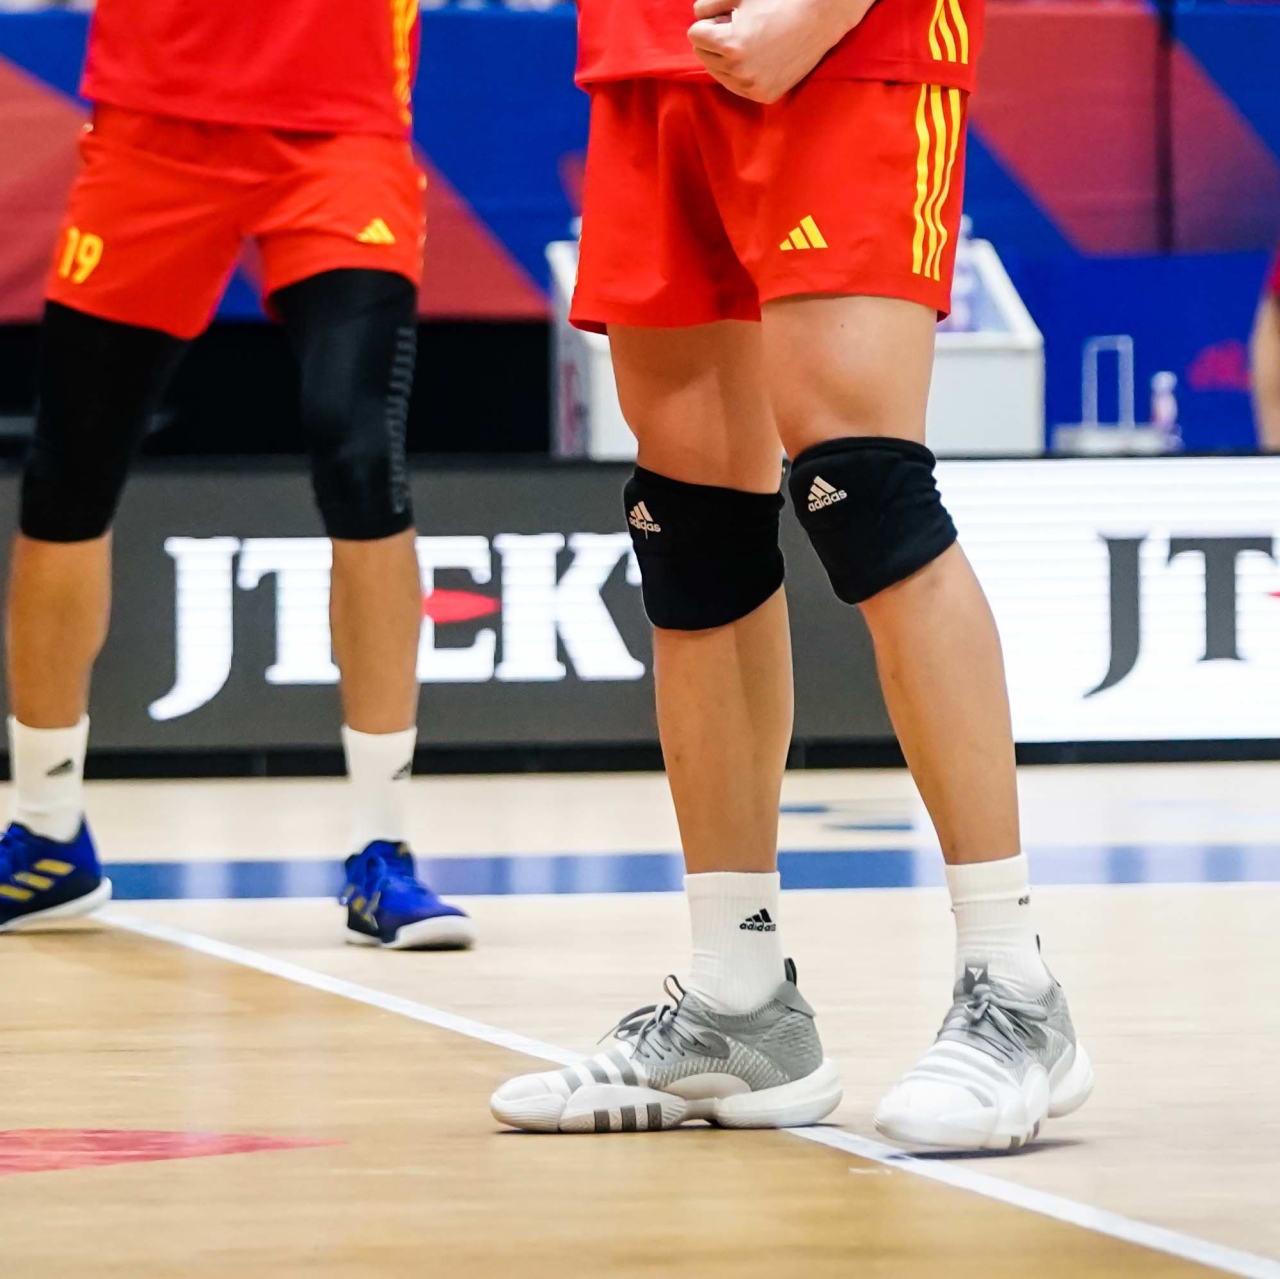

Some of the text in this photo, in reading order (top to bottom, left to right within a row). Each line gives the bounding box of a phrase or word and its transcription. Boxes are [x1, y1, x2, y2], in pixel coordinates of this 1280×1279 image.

[58, 227, 104, 284] 19
[808, 490, 848, 512] adidas
[148, 535, 644, 721] JTEK
